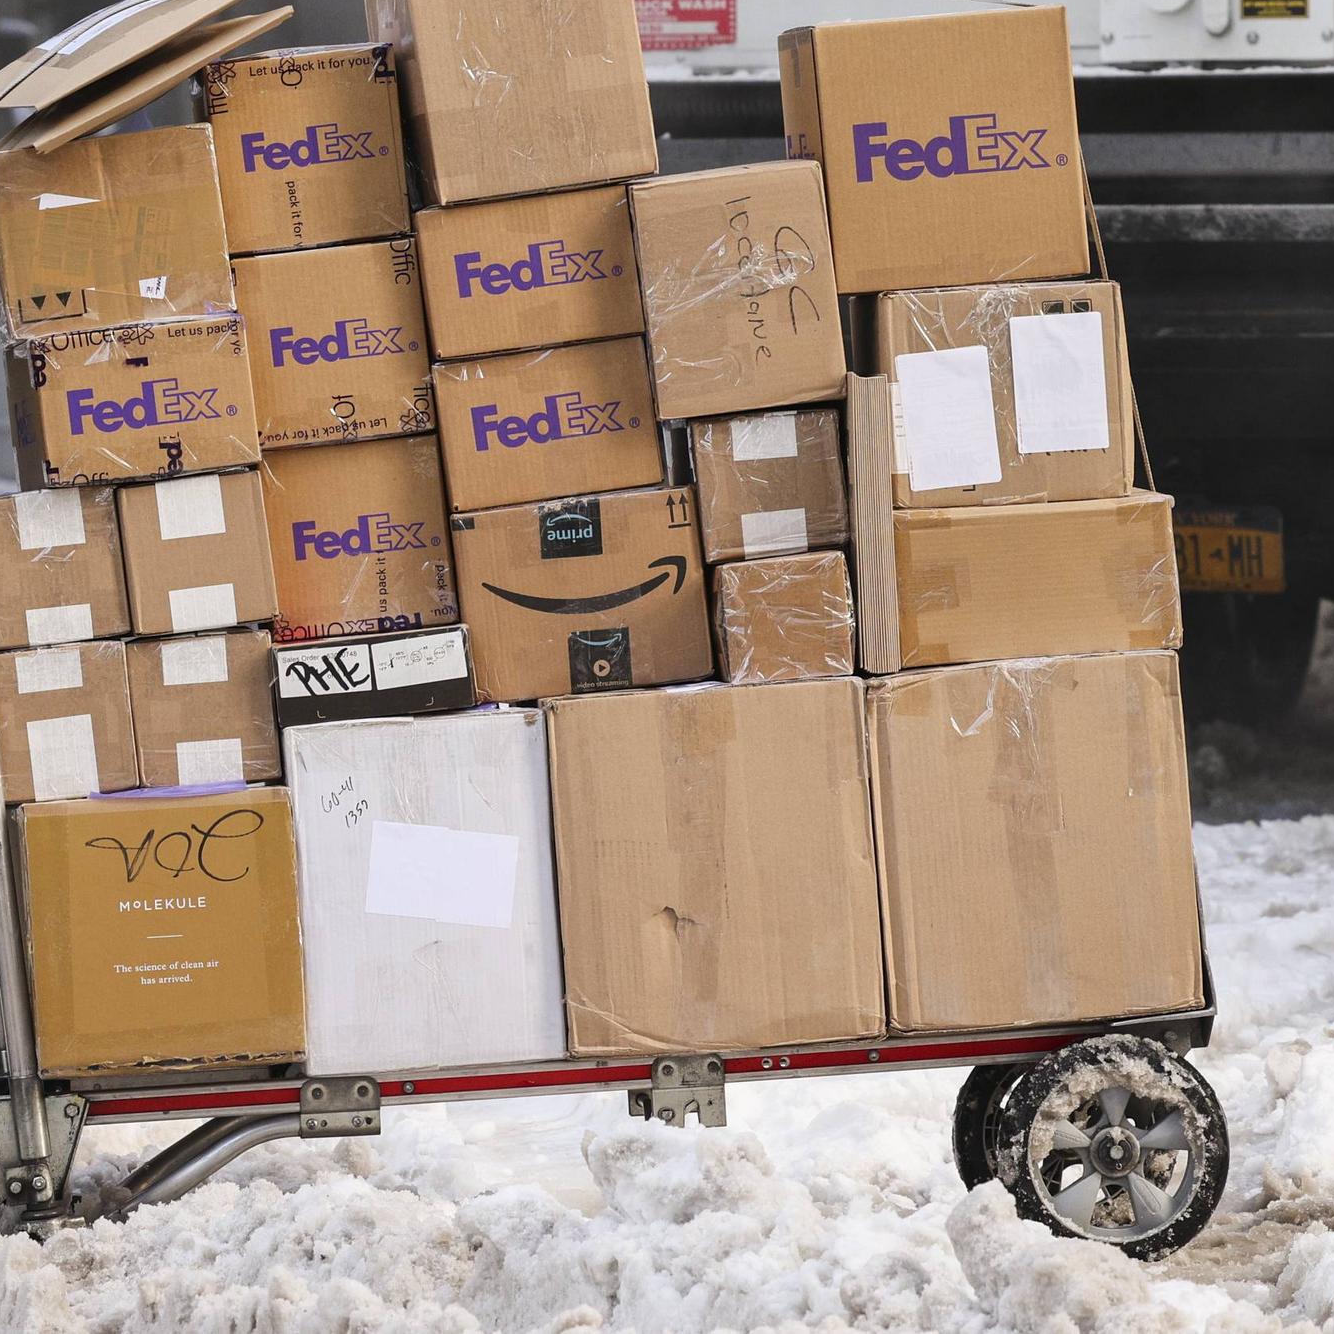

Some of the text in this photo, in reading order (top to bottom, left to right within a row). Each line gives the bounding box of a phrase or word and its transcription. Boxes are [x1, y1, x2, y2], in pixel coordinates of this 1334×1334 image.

[249, 65, 268, 77] Let
[317, 57, 326, 70] it
[329, 56, 345, 69] for
[241, 123, 375, 173] FedEx
[852, 113, 1051, 183] FedEx
[285, 180, 303, 238] pack it for
[454, 240, 607, 298] FedEx
[167, 327, 184, 338] Let
[188, 325, 203, 336] us
[270, 318, 405, 367] FedEx
[67, 378, 221, 435] FedEx
[471, 392, 624, 452] FedEx
[292, 513, 427, 561] FedEx
[547, 525, 593, 543] prime
[376, 569, 389, 596] pack
[577, 678, 629, 688] video streaming
[114, 959, 220, 973] The science of clean air
[141, 974, 193, 985] has arrived.
